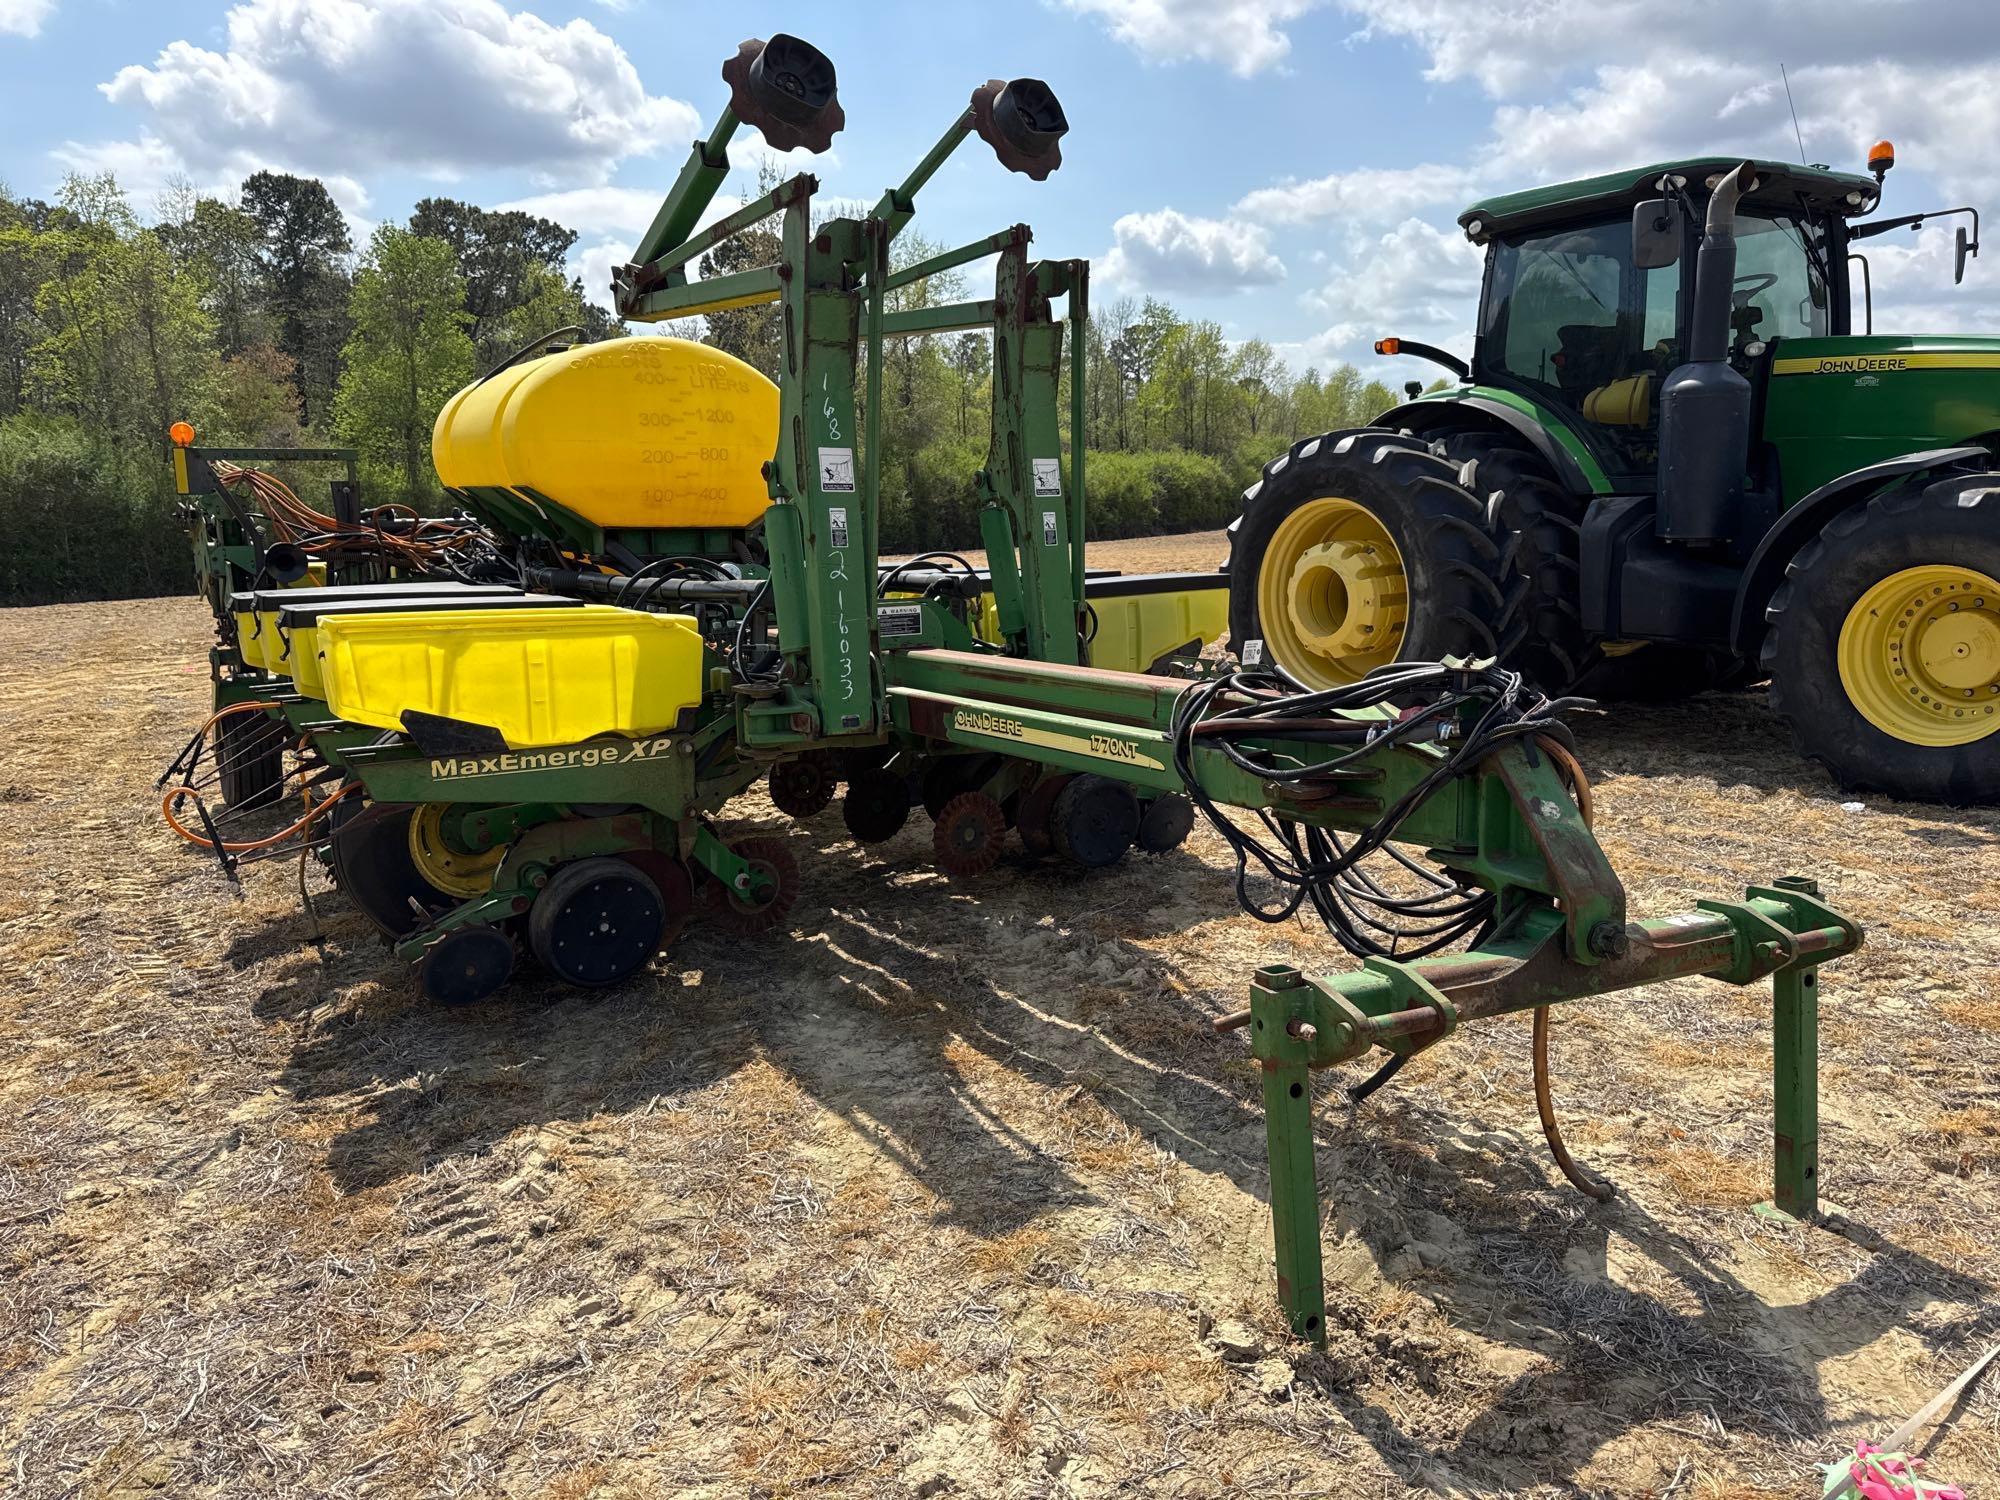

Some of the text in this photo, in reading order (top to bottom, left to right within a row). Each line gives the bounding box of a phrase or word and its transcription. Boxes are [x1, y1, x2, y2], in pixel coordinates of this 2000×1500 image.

[1814, 358, 1907, 373] JOHN DEERE
[690, 375, 750, 394] LITERS
[954, 710, 1023, 736] OHN DEERE
[431, 738, 672, 778] MaxEmerge XP
[1090, 734, 1139, 759] 1770NT
